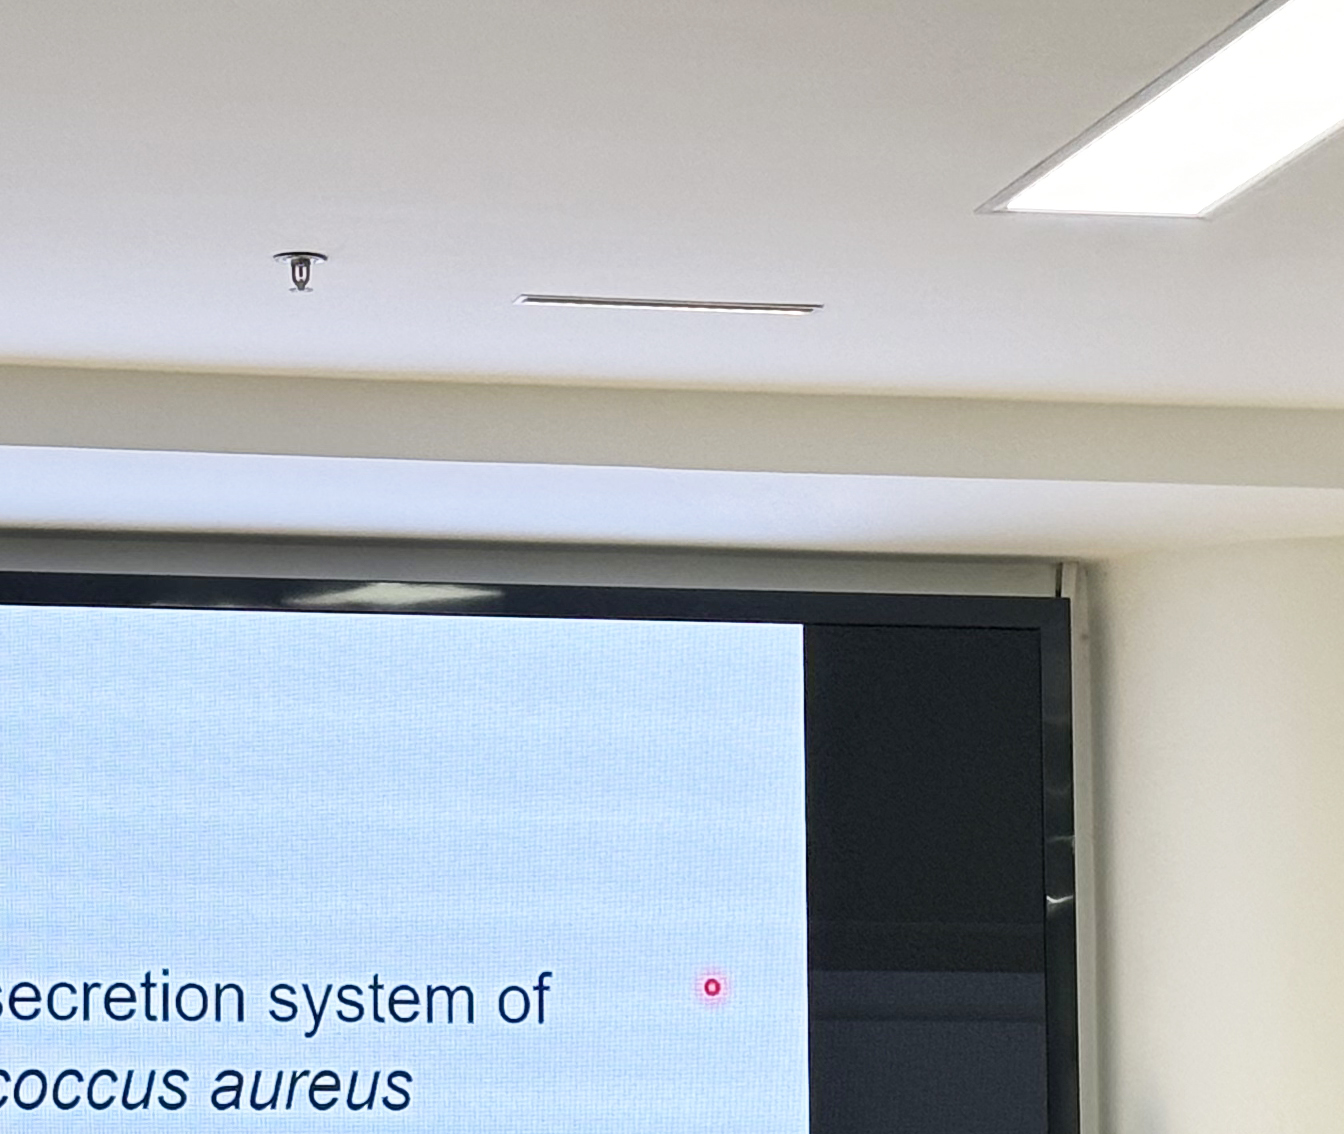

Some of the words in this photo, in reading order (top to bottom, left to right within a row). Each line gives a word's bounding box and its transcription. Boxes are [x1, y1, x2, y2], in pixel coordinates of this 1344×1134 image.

[268, 973, 474, 1038] system
[498, 971, 553, 1024] of
[210, 1069, 413, 1111] aureus
